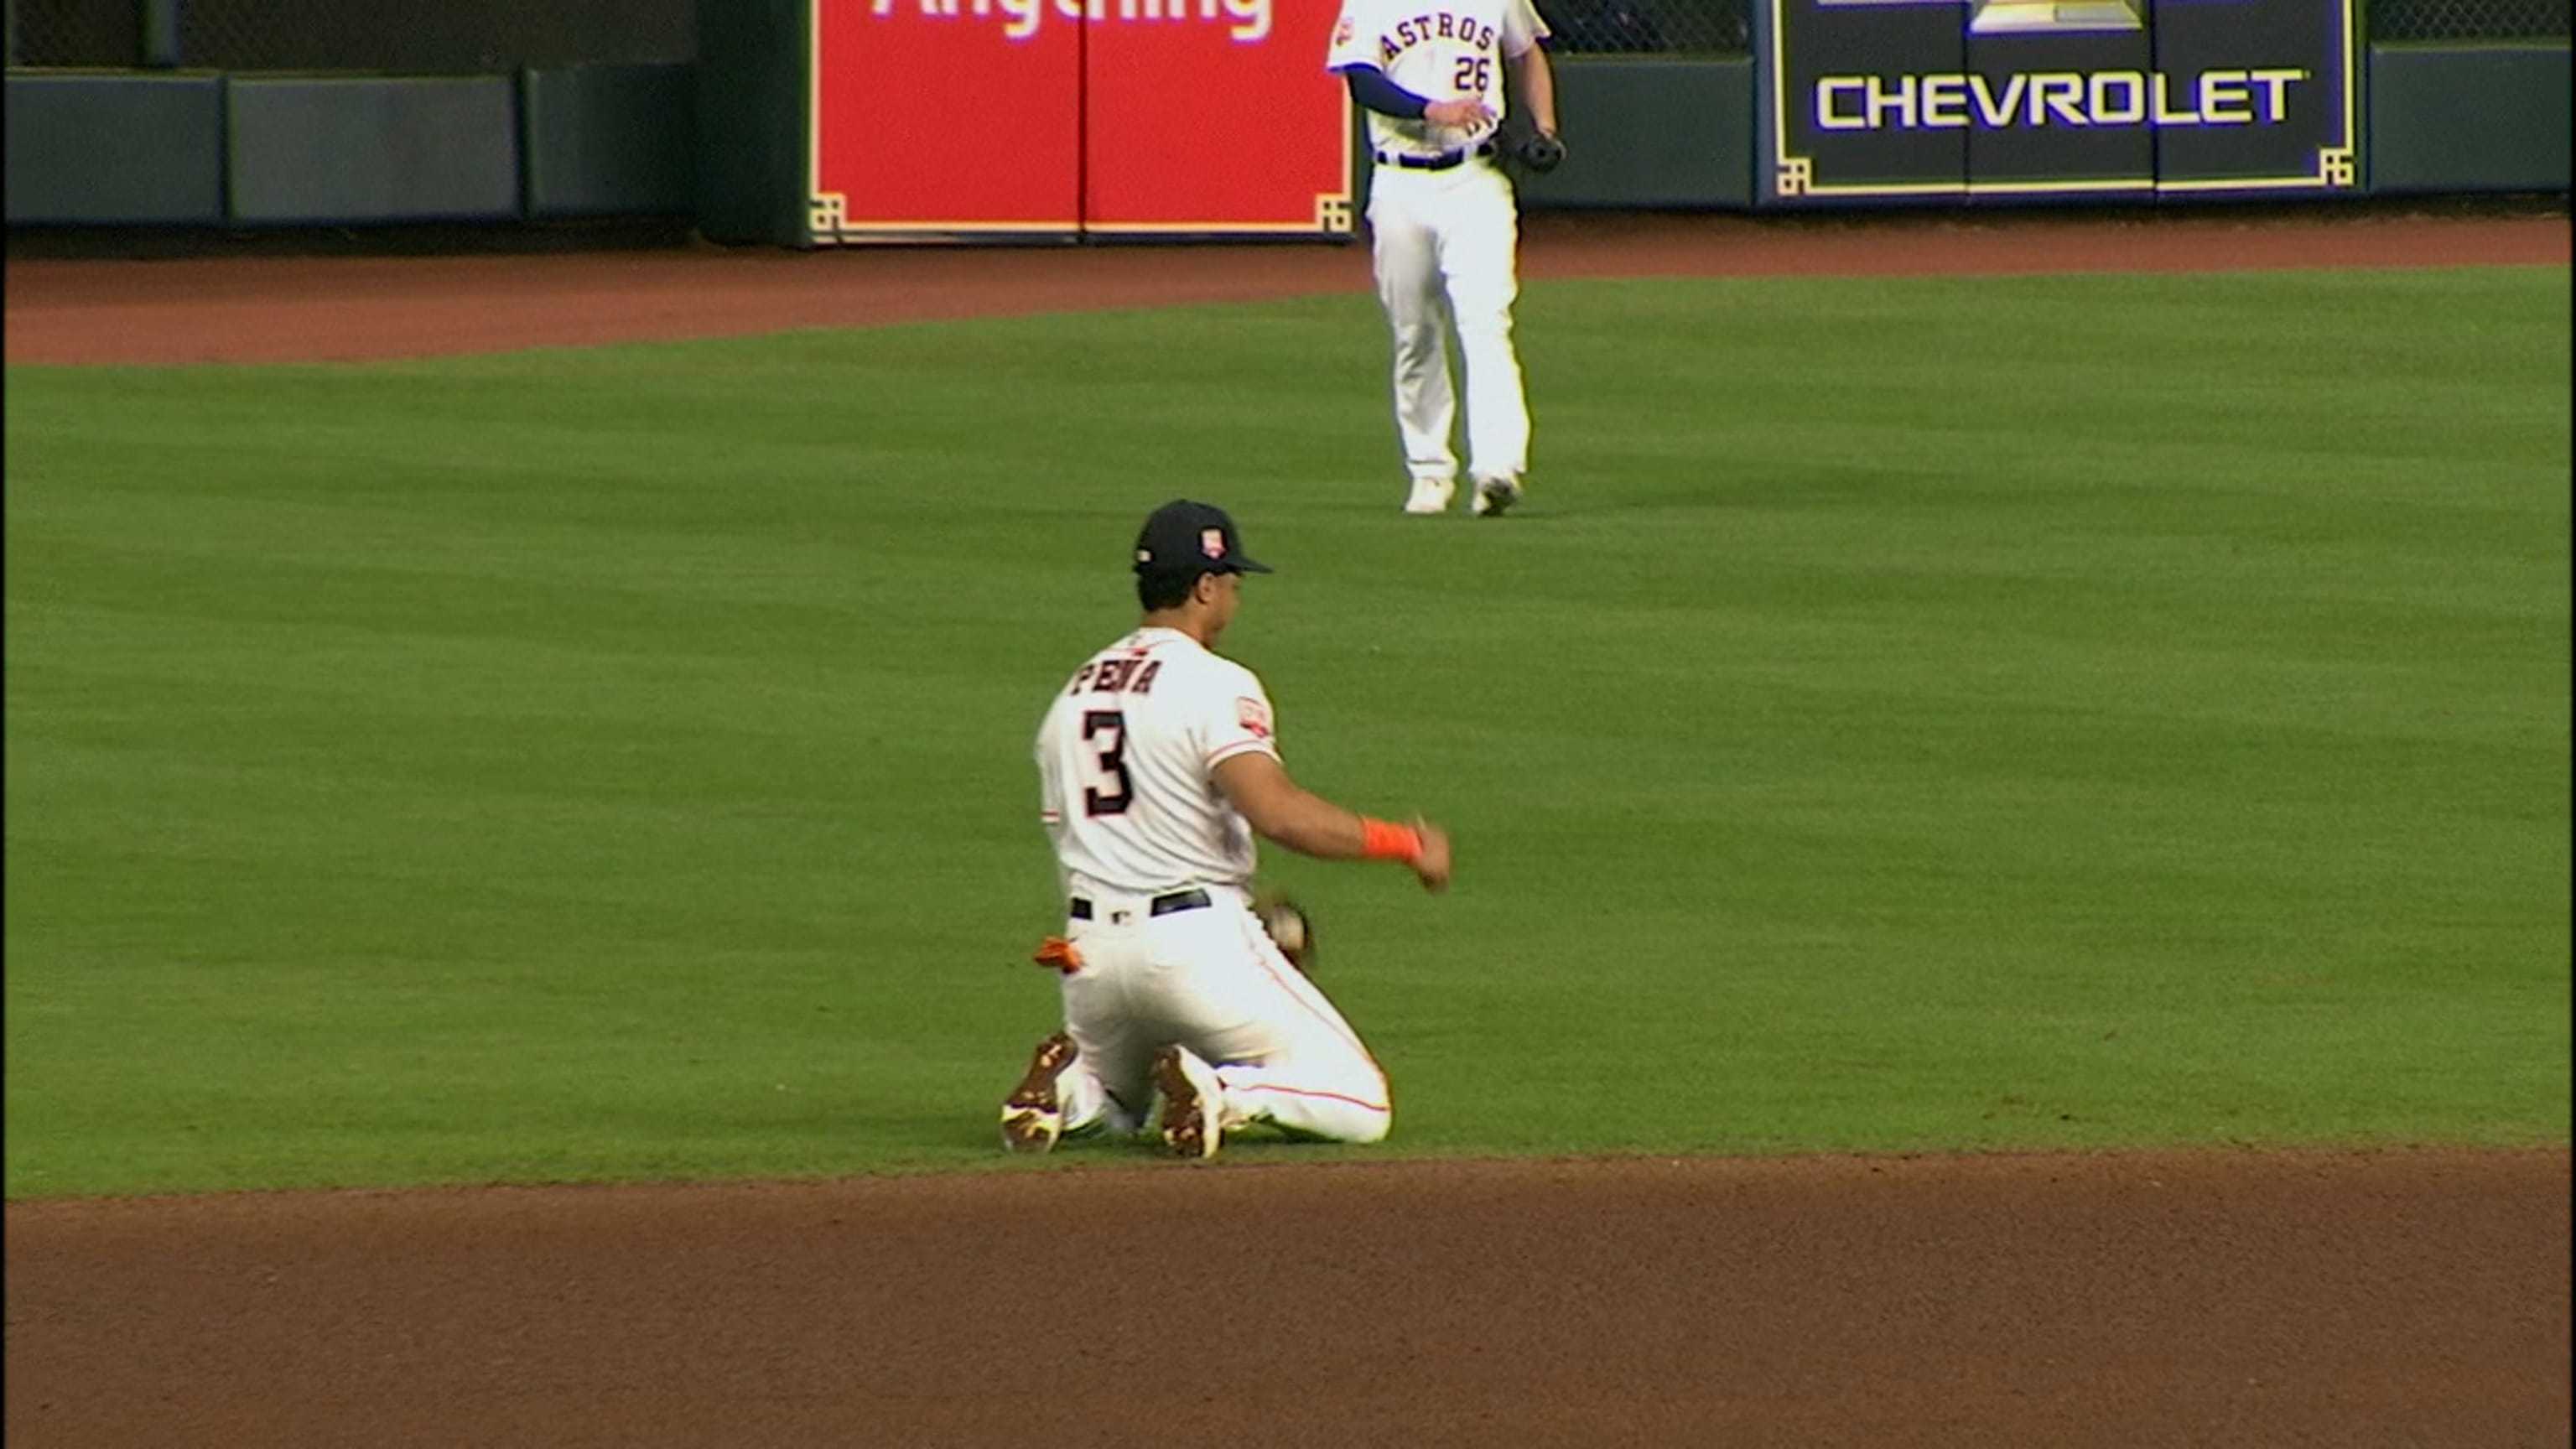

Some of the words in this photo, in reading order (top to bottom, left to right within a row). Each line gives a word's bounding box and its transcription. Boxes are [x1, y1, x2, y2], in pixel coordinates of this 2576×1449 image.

[1381, 13, 1494, 60] ASTROS
[1456, 56, 1490, 91] 26
[1815, 70, 2307, 129] CHEVROLET
[1083, 709, 1135, 817] 3
